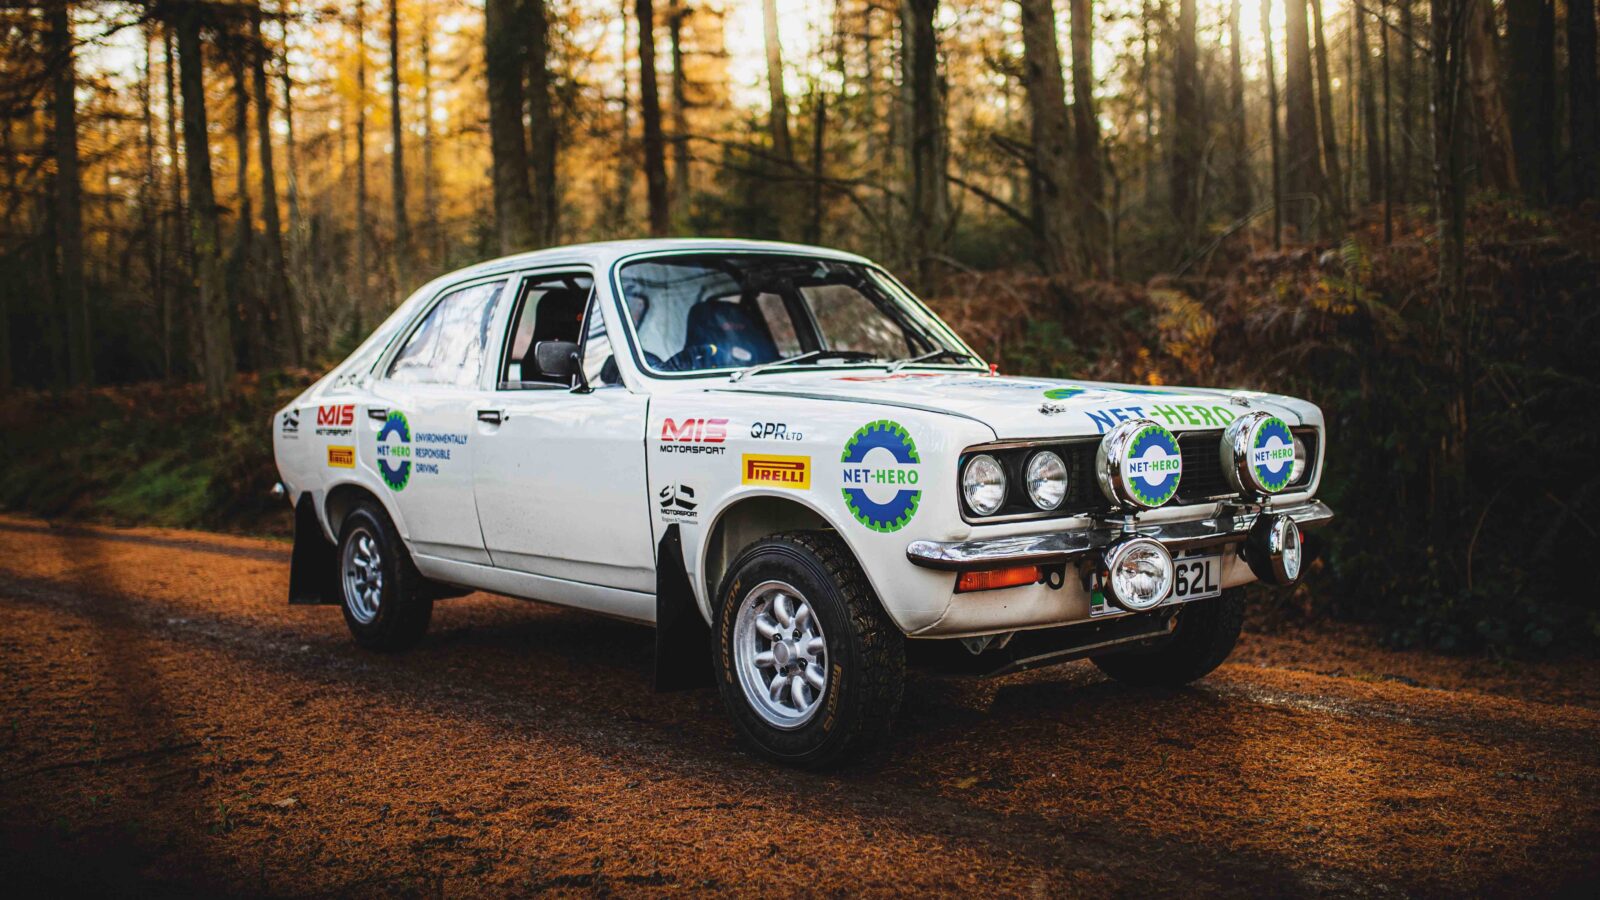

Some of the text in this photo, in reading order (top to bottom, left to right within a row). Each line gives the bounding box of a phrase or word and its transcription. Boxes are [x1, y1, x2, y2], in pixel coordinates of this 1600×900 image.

[317, 405, 355, 426] MIS
[316, 428, 352, 437] MOTORSPORT
[661, 417, 729, 443] MIS
[750, 421, 787, 440] QPR
[415, 432, 468, 445] ENVIRONMENTALLY
[329, 449, 353, 465] PIRELLI
[377, 445, 411, 457] NET-HERO
[415, 447, 451, 460] RESPONSIBLE
[660, 445, 726, 455] MOTORSPORT
[1255, 448, 1293, 462] NET-HERO
[415, 463, 439, 475] DRIVING
[747, 459, 805, 483] PIRELLI
[1129, 458, 1179, 473] NET-HERO
[843, 468, 919, 485] NET-HERO
[661, 508, 698, 517] MOTORSPORT
[1167, 561, 1218, 599] 62L
